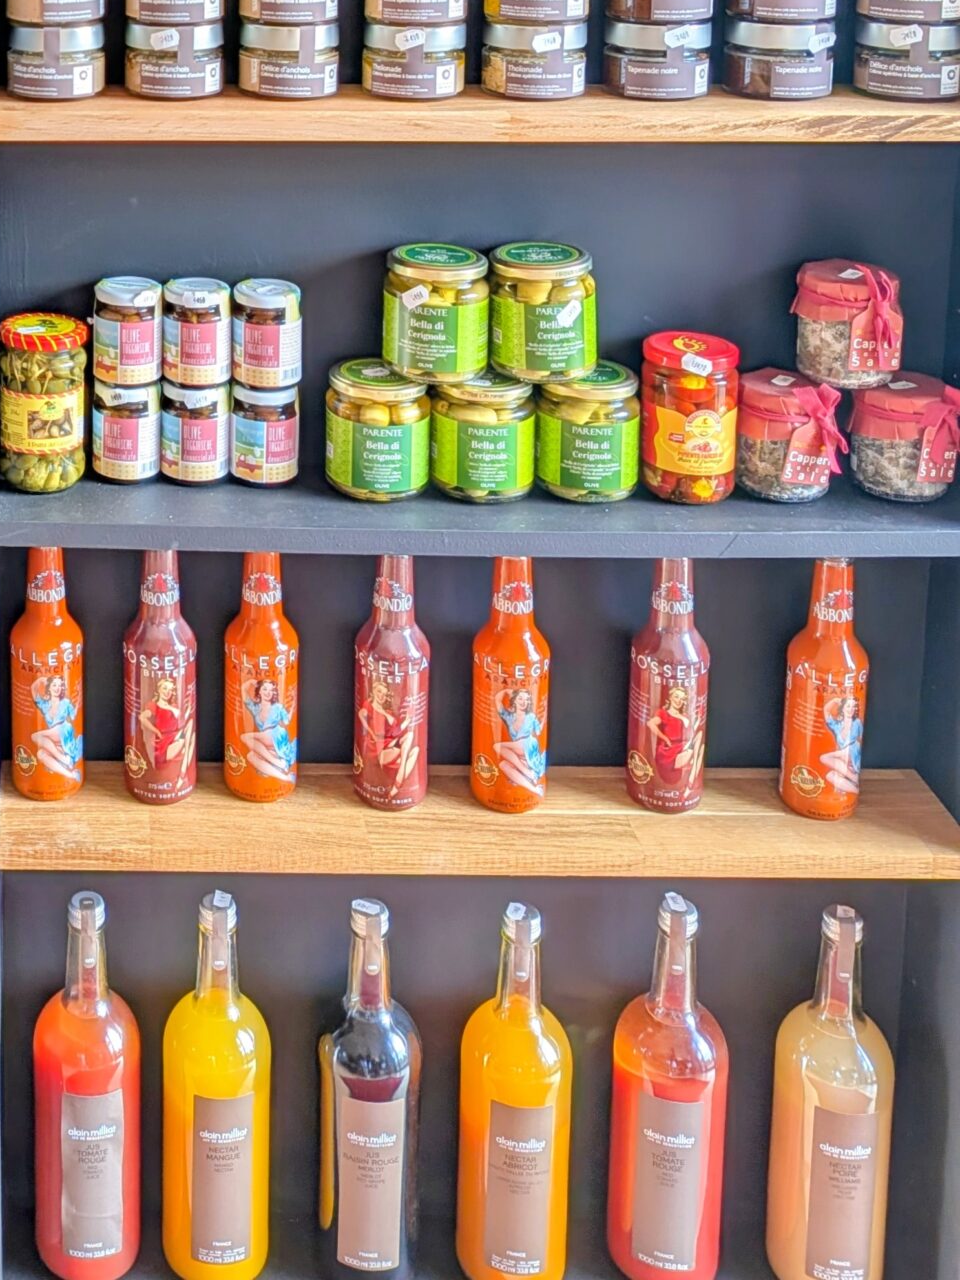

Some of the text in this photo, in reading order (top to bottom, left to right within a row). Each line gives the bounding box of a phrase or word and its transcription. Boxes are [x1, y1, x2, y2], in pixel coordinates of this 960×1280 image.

[627, 66, 678, 75] Tapenade noire
[410, 319, 444, 330] Bella di
[408, 330, 446, 342] Cerignola
[363, 428, 403, 437] PARENTE
[468, 427, 509, 437] PARENTE
[572, 426, 613, 436] PARENTE
[366, 440, 400, 450] Bella di
[471, 440, 506, 450] Bella di
[575, 439, 610, 450] Bella di
[363, 452, 402, 462] Cerignola
[468, 452, 508, 462] Cerignola
[572, 451, 612, 462] Cerignola
[142, 668, 186, 678] BITTER
[361, 667, 402, 684] BITTER
[654, 676, 696, 687] BITTER
[67, 1124, 116, 1138] alain milliat
[222, 1127, 248, 1139] milliat
